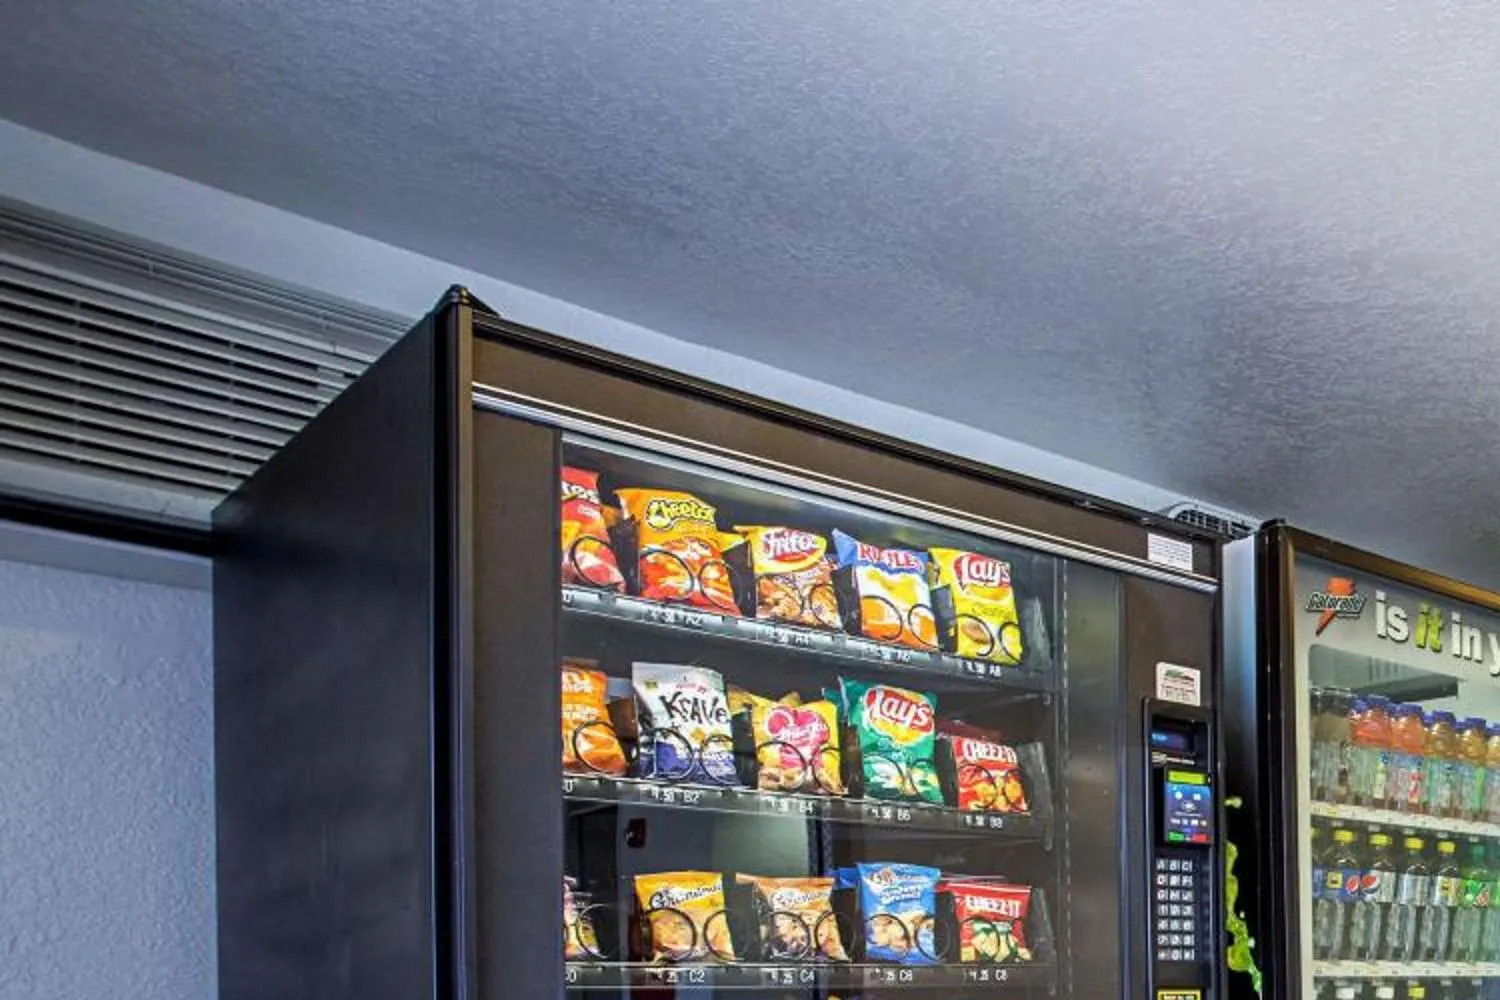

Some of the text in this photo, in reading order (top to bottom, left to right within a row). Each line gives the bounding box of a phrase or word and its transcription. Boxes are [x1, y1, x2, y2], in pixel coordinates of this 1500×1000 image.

[961, 554, 1011, 586] Lay's
[1375, 589, 1410, 643] is
[1414, 601, 1443, 653] it
[1451, 611, 1485, 664] in
[875, 690, 931, 730] Lay's
[689, 969, 704, 983] C2
[800, 970, 815, 983] C4
